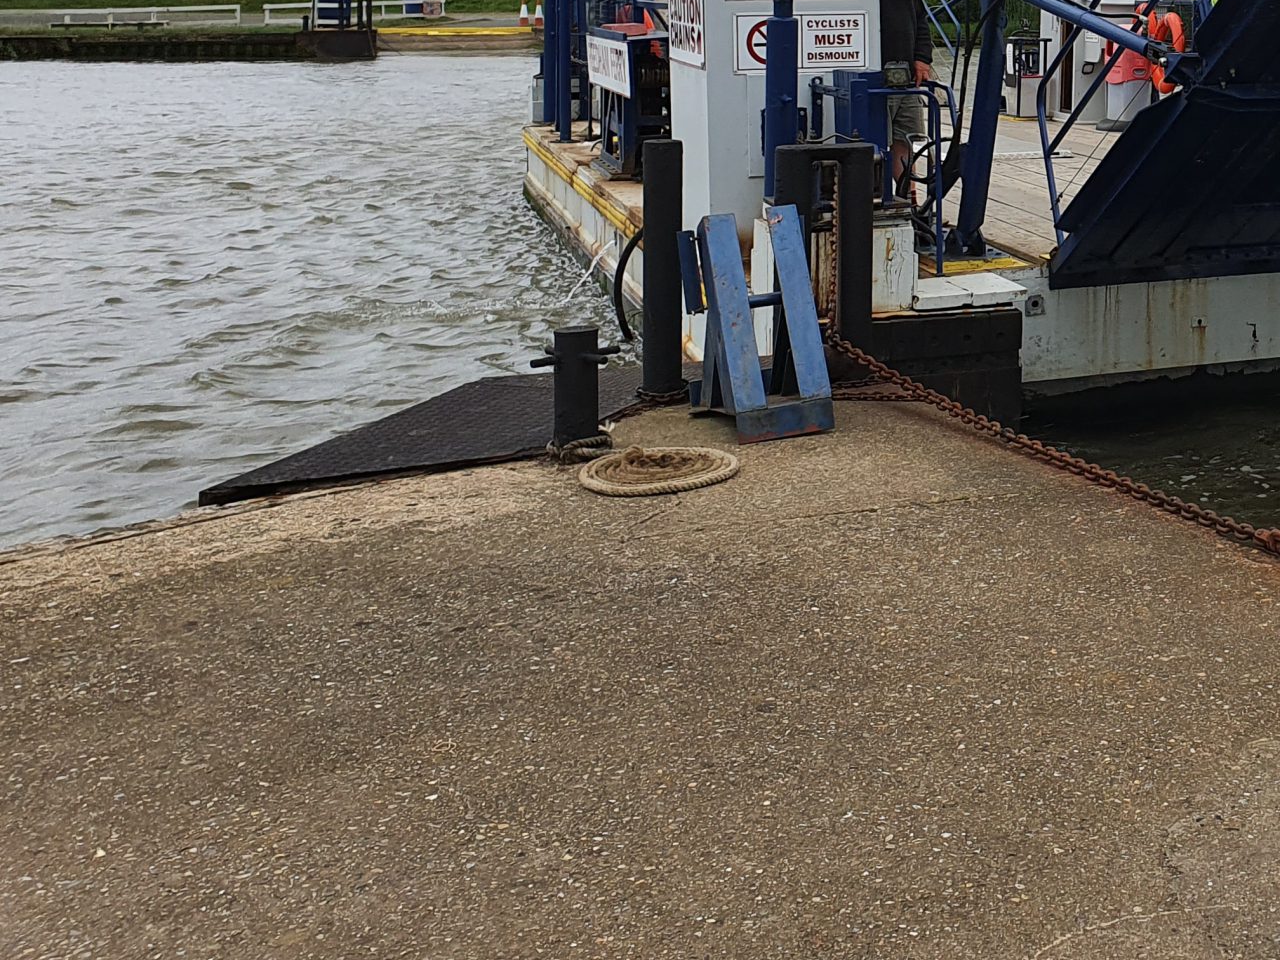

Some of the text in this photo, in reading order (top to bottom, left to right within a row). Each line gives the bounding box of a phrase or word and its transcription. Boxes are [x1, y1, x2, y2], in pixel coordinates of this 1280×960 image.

[806, 19, 860, 29] CYCLISTS
[670, 21, 696, 54] CHAINS
[814, 33, 853, 46] MUST
[807, 50, 860, 61] DISMOUNT
